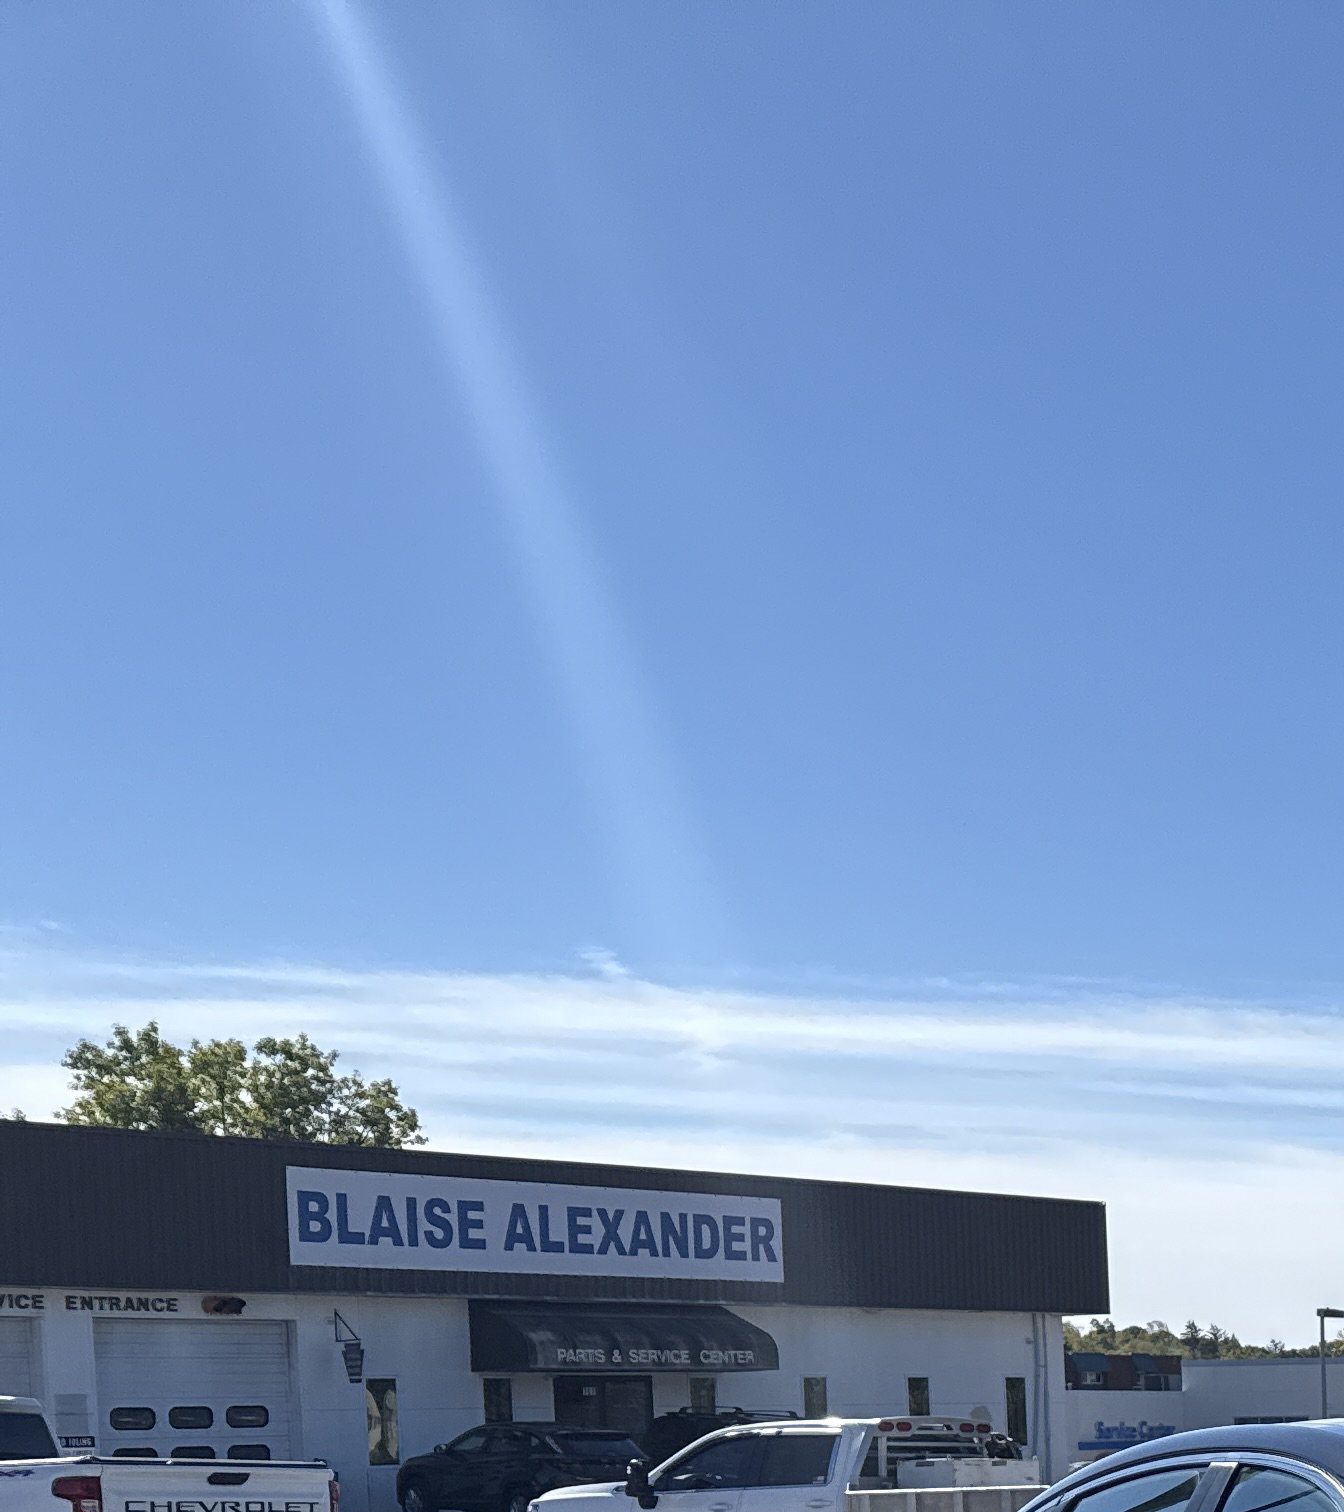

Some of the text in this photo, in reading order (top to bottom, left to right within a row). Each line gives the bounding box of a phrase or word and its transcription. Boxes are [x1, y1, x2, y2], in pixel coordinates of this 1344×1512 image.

[296, 1189, 778, 1263] BLAISE ALEXANDER
[65, 1295, 179, 1313] ENTRANCE
[557, 1348, 755, 1364] PARTS & SERVICE CENTER
